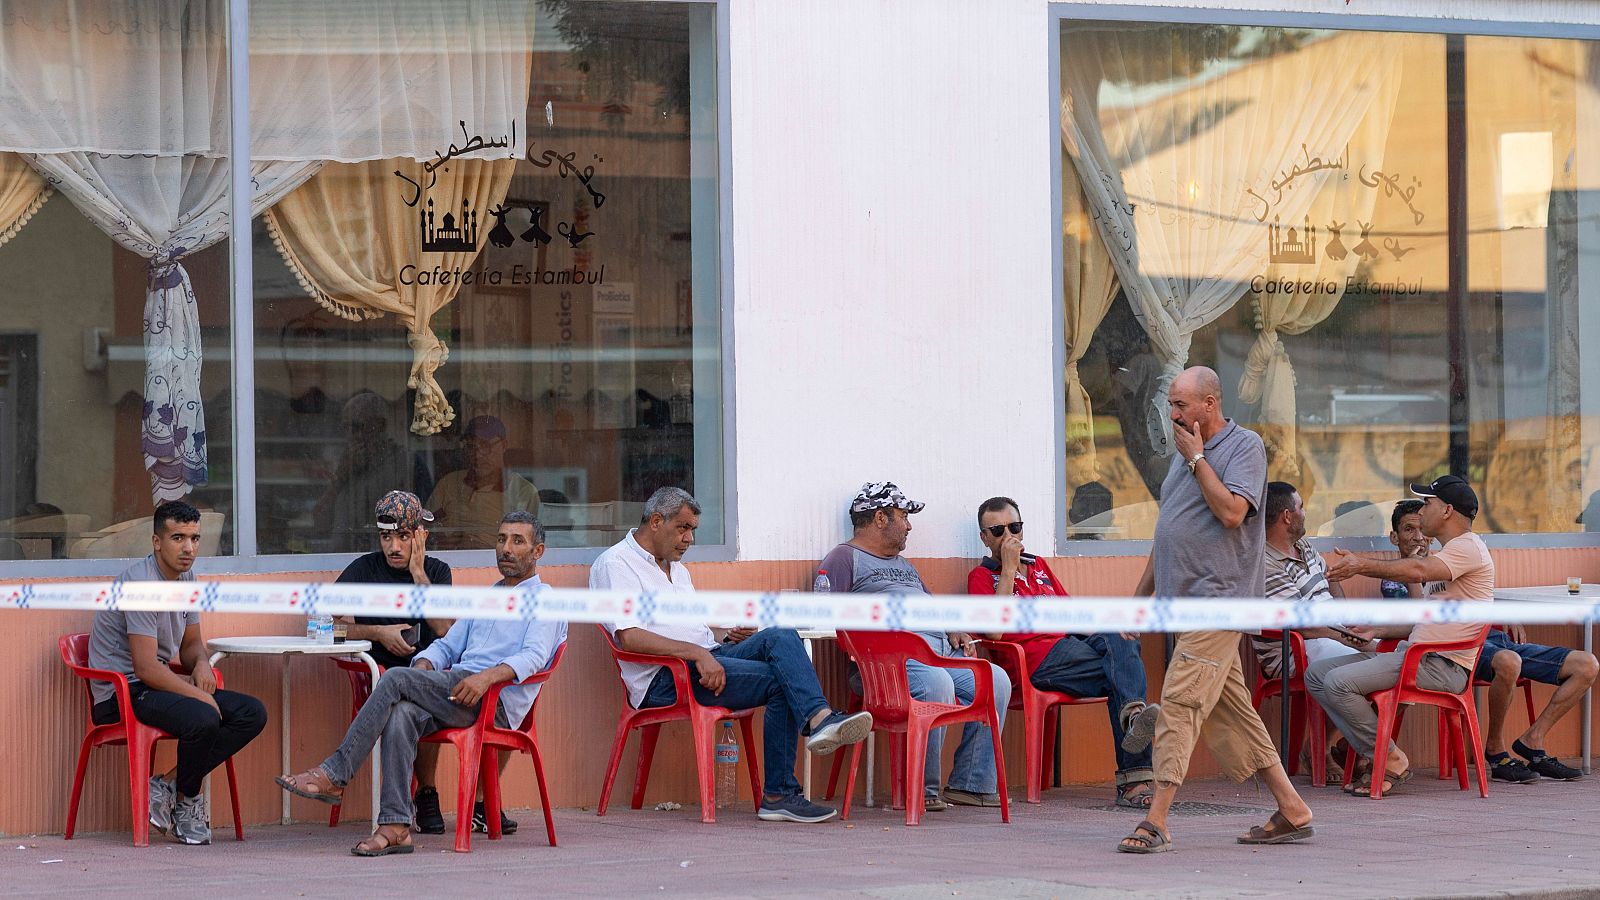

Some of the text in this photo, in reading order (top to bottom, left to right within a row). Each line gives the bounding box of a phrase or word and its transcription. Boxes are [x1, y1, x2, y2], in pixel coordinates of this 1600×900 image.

[527, 142, 606, 209] مقهى
[1358, 163, 1425, 226] مقهى
[399, 264, 605, 286] Cafetería Estambul
[1250, 274, 1424, 295] Cafetería Estambul
